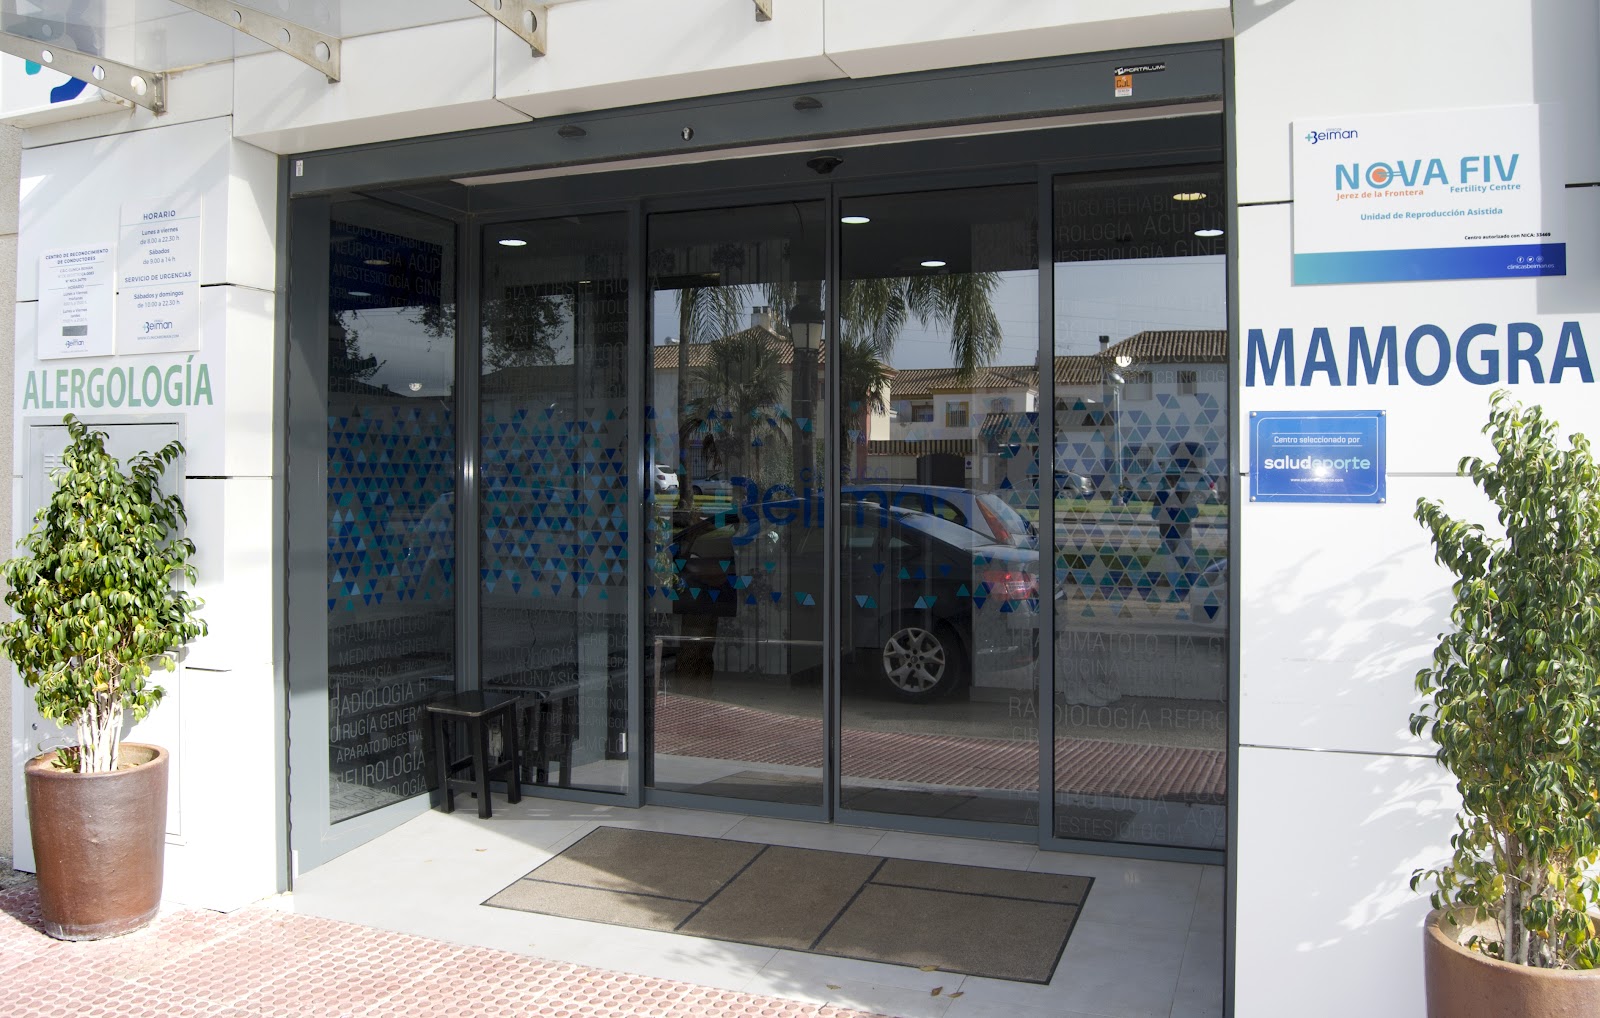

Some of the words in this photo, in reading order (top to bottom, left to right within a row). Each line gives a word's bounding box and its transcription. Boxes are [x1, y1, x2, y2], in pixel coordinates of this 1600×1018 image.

[1336, 159, 1449, 190] NOVA
[1460, 154, 1519, 184] FIV
[1450, 184, 1487, 193] Fertility
[1489, 183, 1521, 191] Centre
[1336, 193, 1359, 201] Jerez
[1385, 189, 1424, 197] Frontera
[143, 210, 176, 220] HORARIO
[1361, 212, 1391, 220] Unidad
[1393, 211, 1403, 219] de
[1405, 208, 1465, 220] Reproducción
[1467, 207, 1503, 216] Asistida
[45, 252, 62, 260] CENTRO
[69, 248, 109, 257] RECONOCIMIENTO
[64, 256, 96, 264] CONDUCTORES
[125, 275, 150, 283] SERVICIO
[160, 272, 192, 280] URGENCIAS
[134, 292, 154, 300] Sábados
[1246, 321, 1595, 387] MAMOGRA
[22, 355, 214, 410] ALERGOLOGÍA
[1274, 436, 1298, 444] Centro
[1299, 435, 1346, 444] seleccionado
[1347, 436, 1361, 445] por
